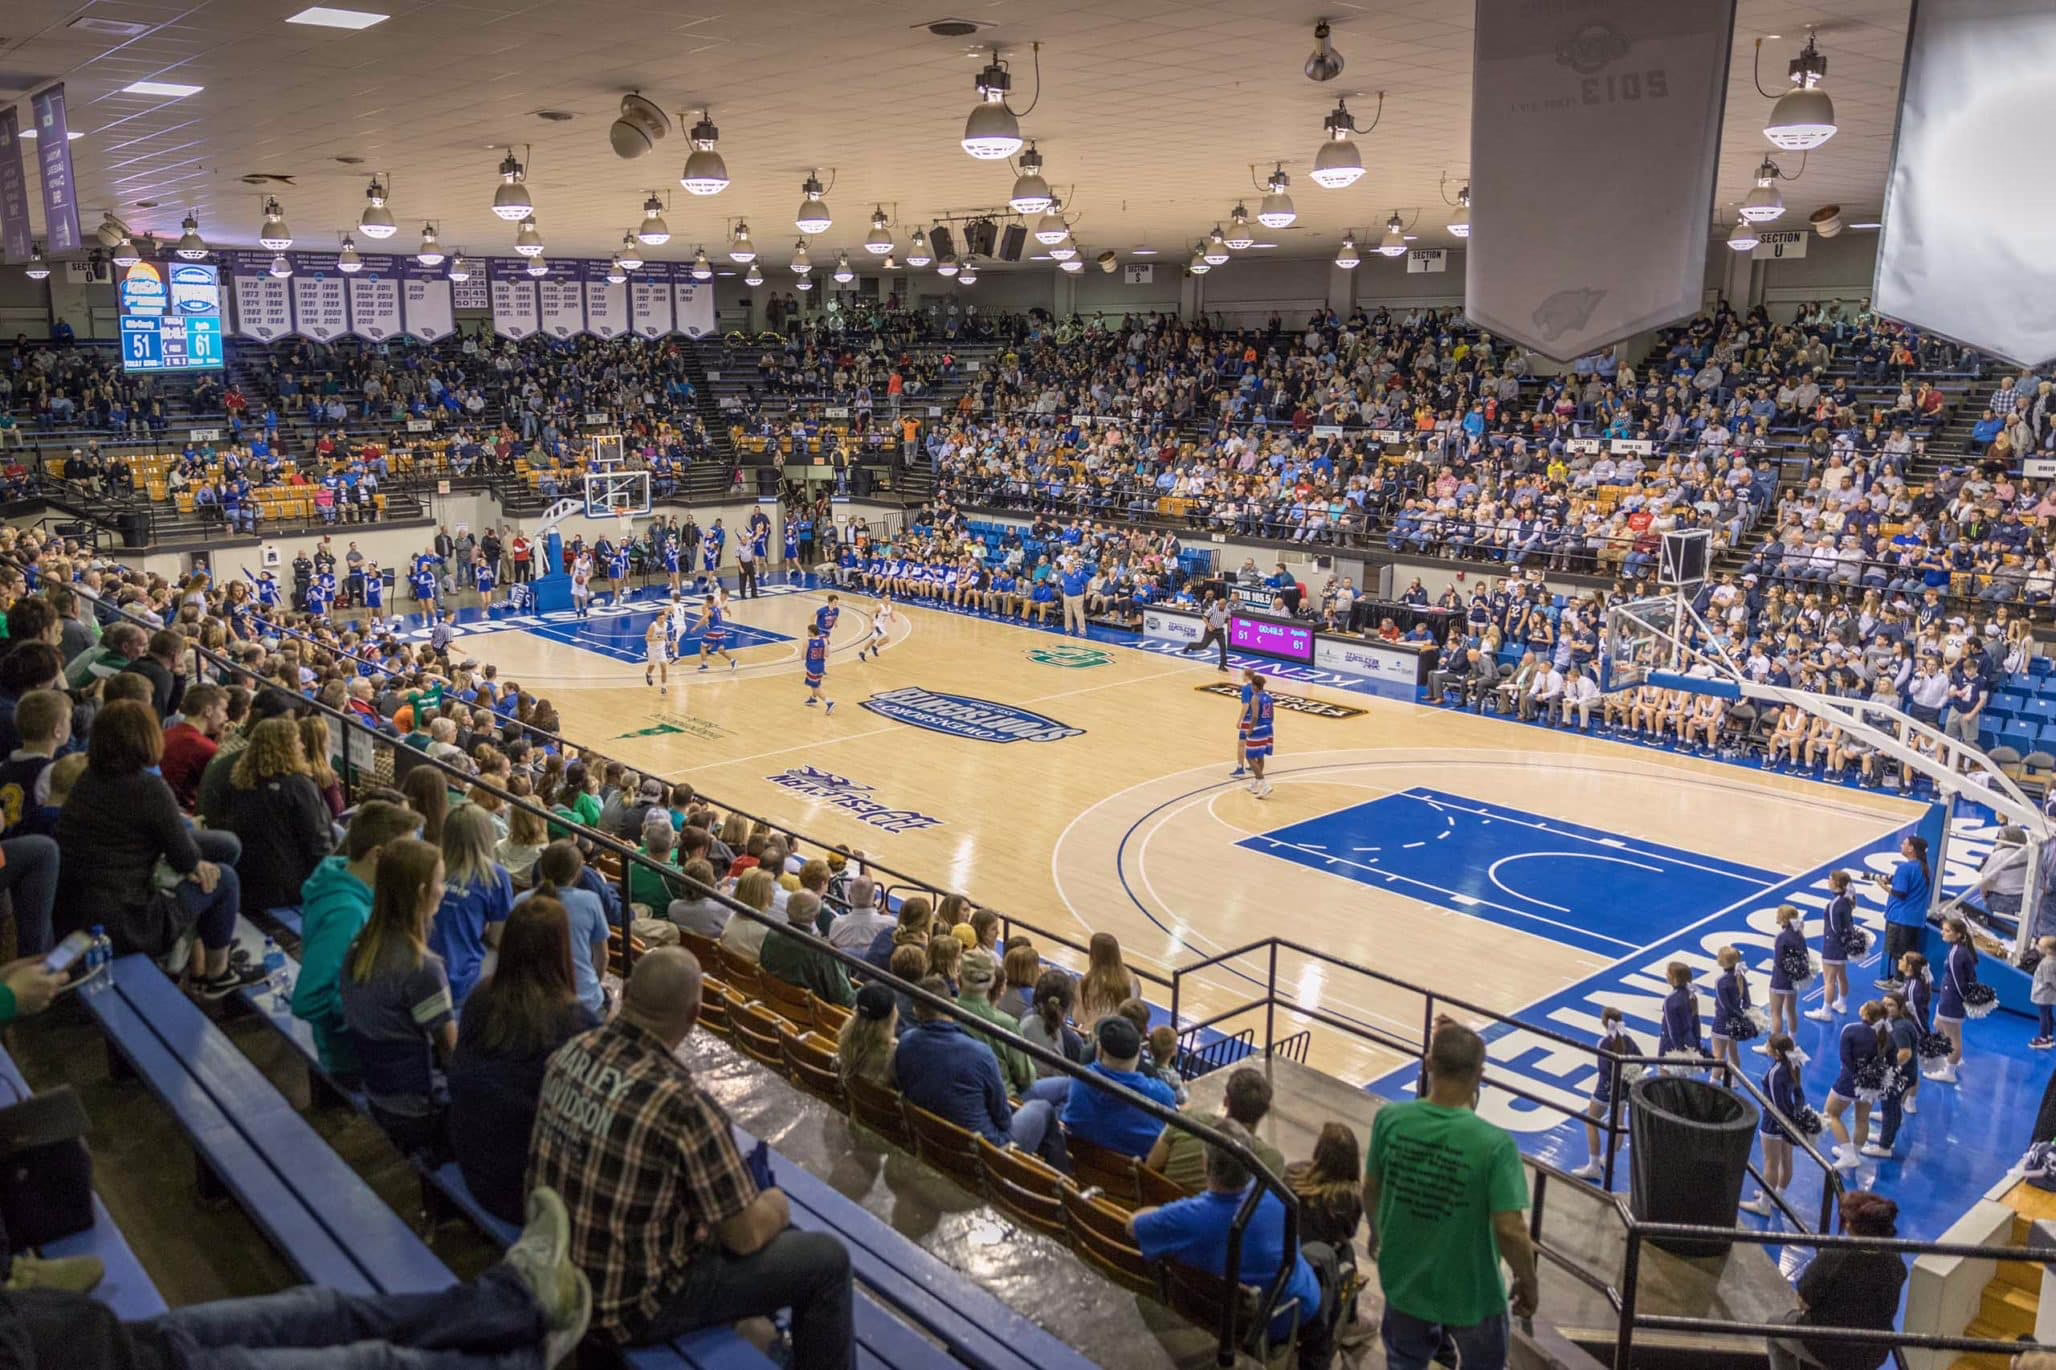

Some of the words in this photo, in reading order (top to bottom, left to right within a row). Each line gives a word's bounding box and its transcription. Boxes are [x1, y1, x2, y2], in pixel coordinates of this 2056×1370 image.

[1760, 232, 1801, 244] SECTION
[1412, 250, 1442, 260] SECTION
[1774, 243, 1783, 257] U
[1424, 259, 1430, 272] T
[1135, 272, 1141, 283] S
[133, 333, 151, 358] 51
[195, 333, 211, 357] 61
[1252, 591, 1271, 604] 105.5
[1238, 630, 1249, 641] 51
[1293, 640, 1304, 651] 61
[1209, 687, 1347, 717] KENTKY
[869, 686, 1087, 742] SPORTSCENTER
[880, 704, 996, 738] OWENSBORO
